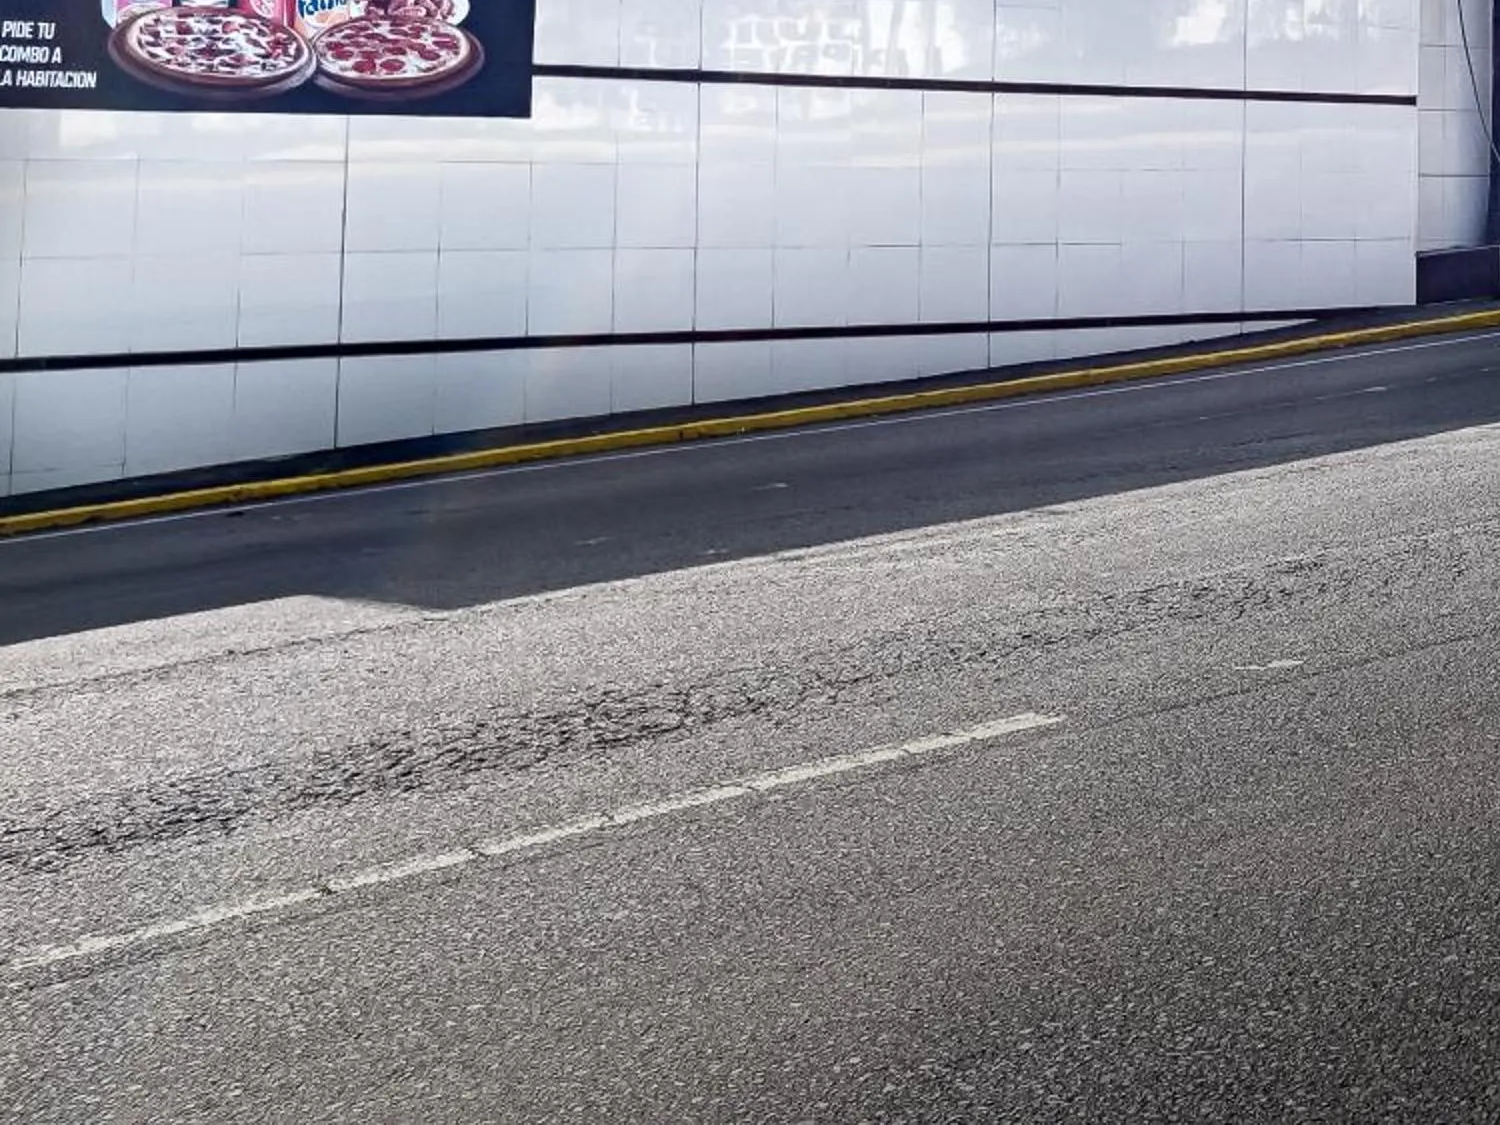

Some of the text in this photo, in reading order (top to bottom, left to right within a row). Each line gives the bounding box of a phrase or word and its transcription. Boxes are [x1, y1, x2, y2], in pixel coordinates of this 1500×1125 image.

[1, 20, 56, 40] PIDE TU
[0, 44, 62, 64] COMBO A
